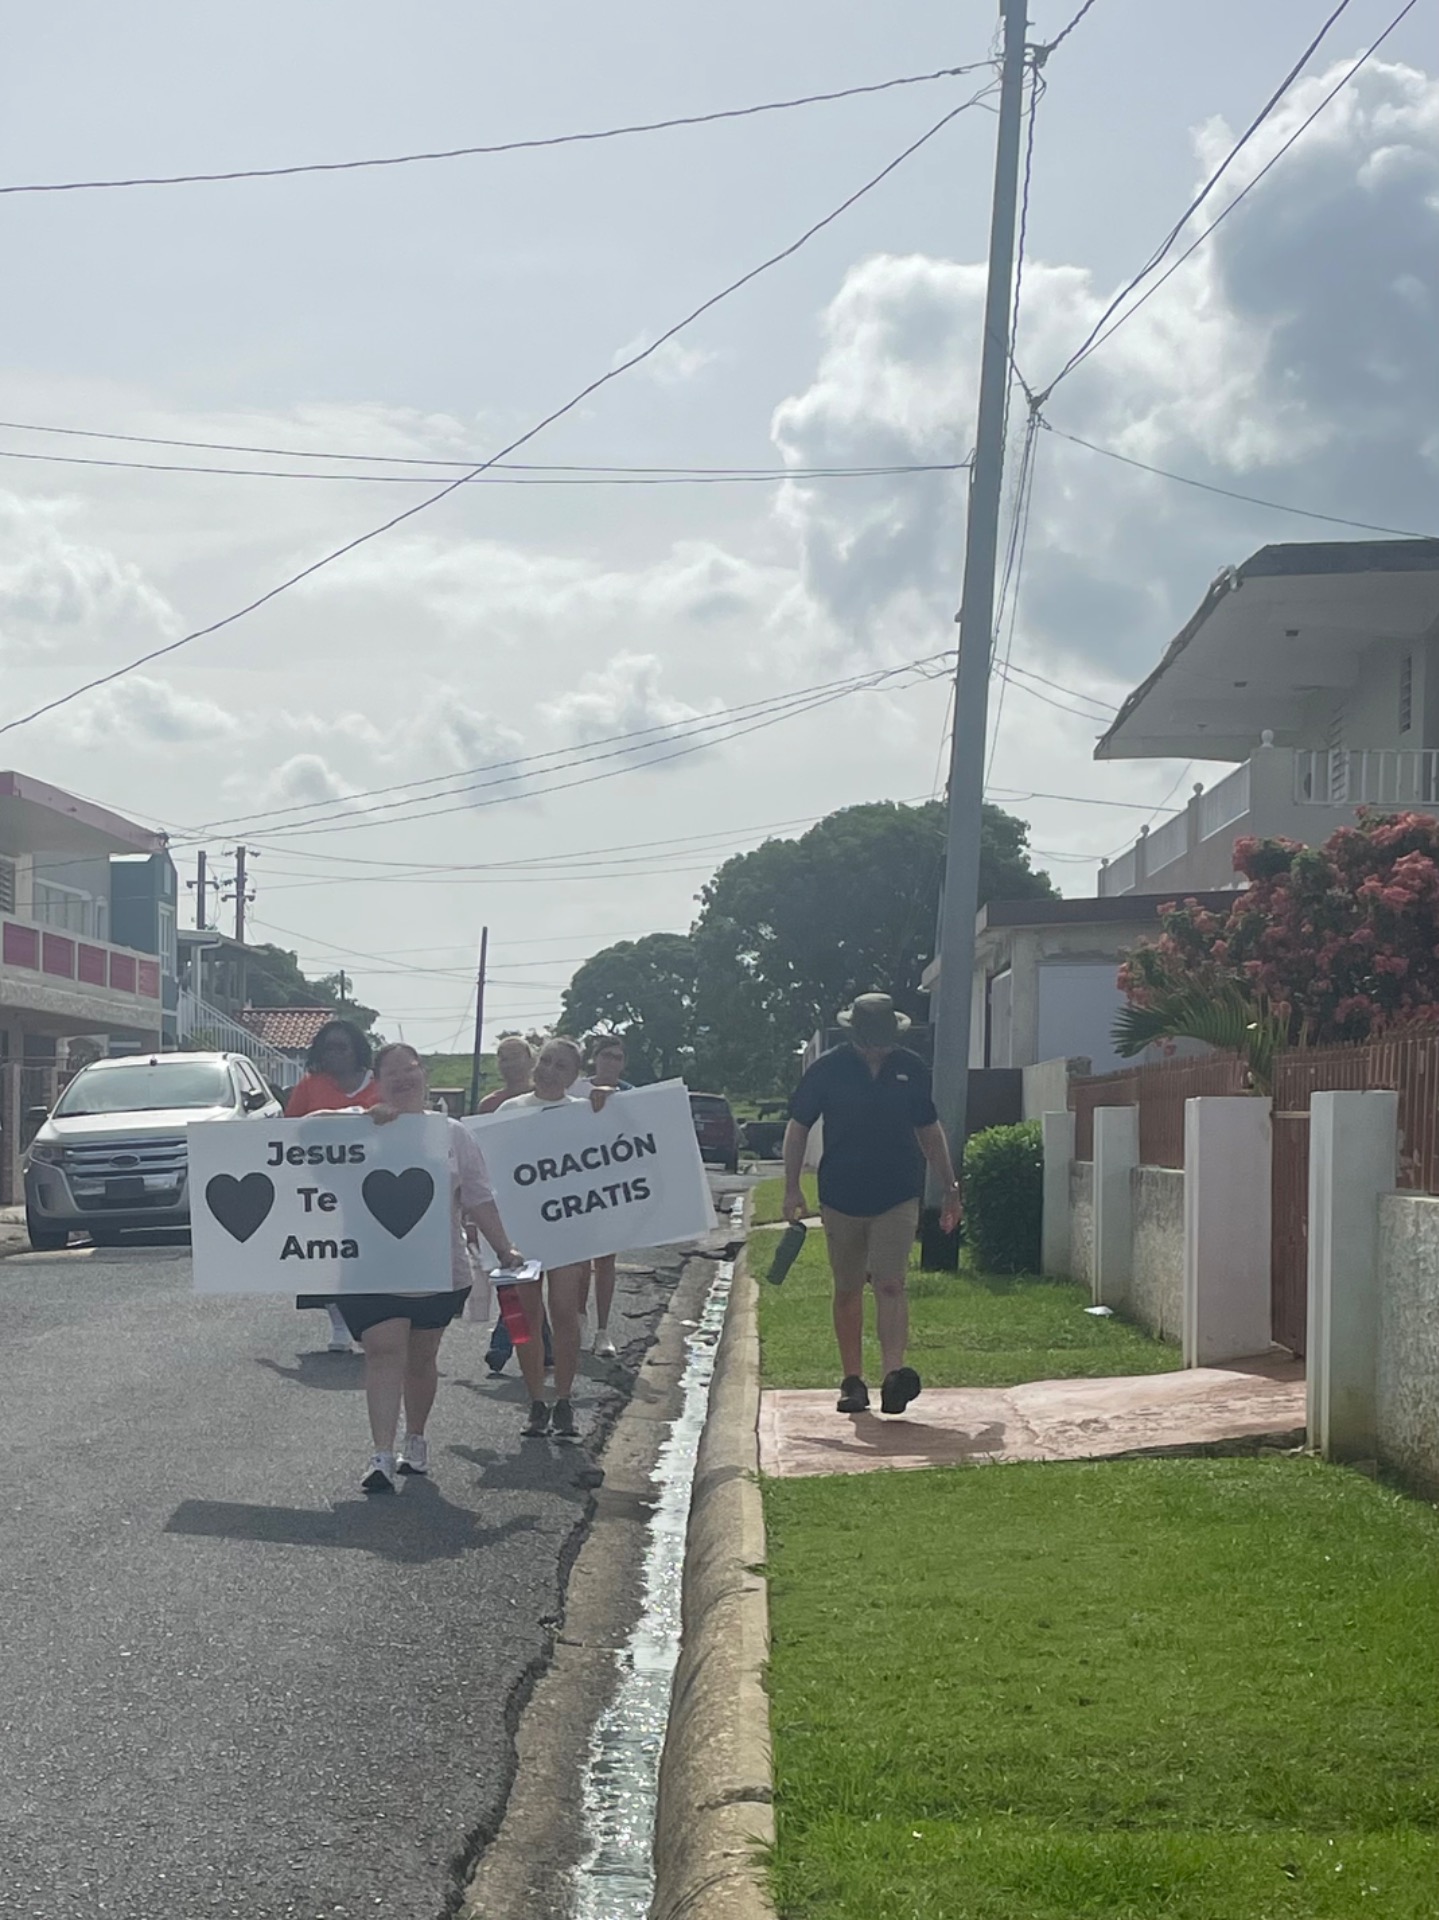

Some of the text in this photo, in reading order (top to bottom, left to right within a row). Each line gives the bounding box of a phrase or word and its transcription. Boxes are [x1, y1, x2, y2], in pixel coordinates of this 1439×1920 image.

[267, 1141, 367, 1167] Jesus
[512, 1131, 658, 1187] ORACIÓN
[296, 1187, 339, 1213] Te
[540, 1176, 651, 1223] GRATIS
[279, 1235, 361, 1261] Ama
